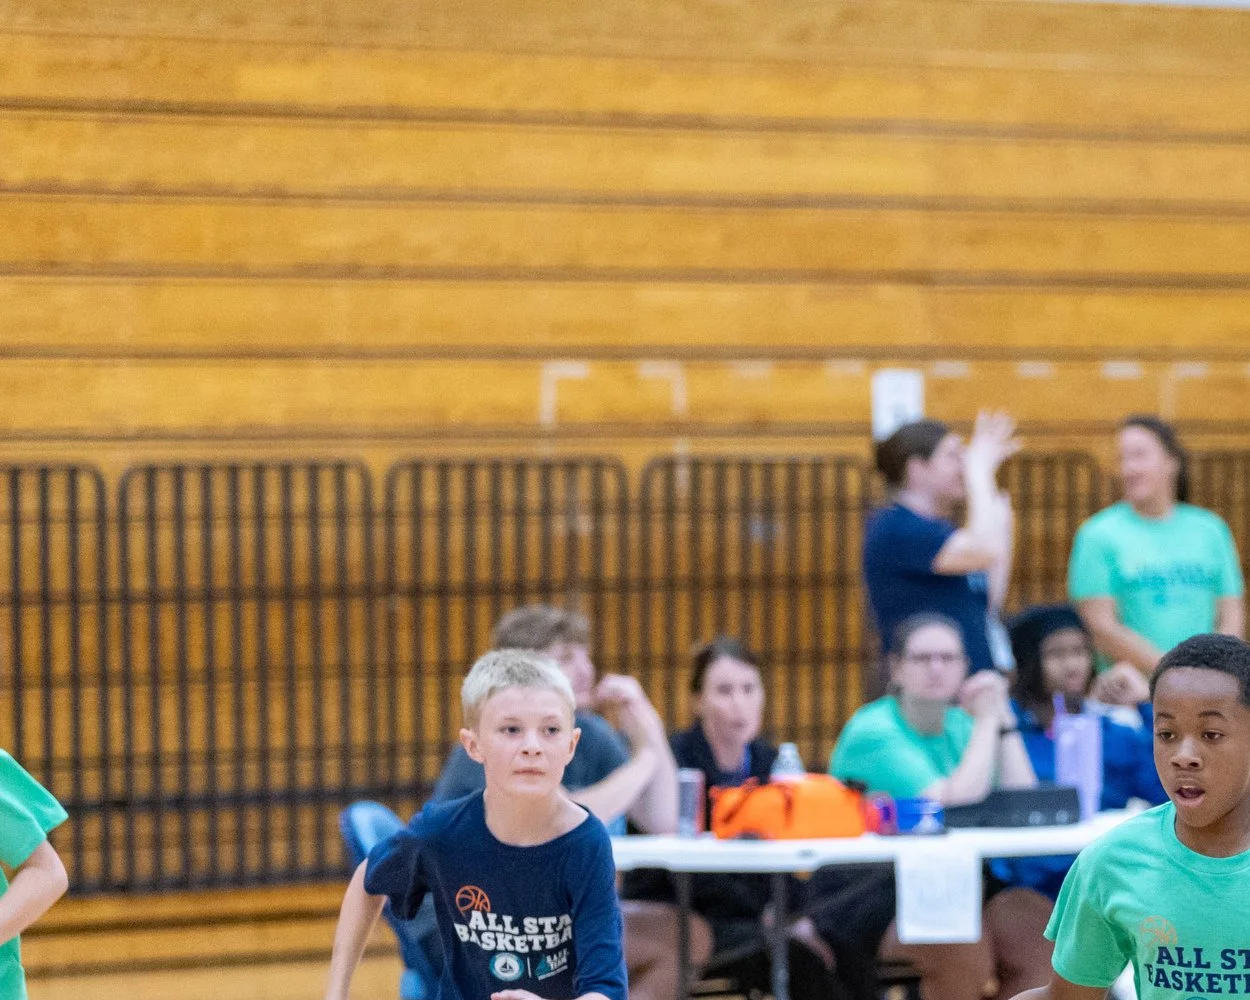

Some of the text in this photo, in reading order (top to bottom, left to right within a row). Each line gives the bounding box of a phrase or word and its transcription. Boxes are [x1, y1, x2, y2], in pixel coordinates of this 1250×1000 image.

[469, 910, 573, 934] ALL STA
[454, 923, 572, 953] BASKETBA
[1156, 945, 1211, 969] ALL
